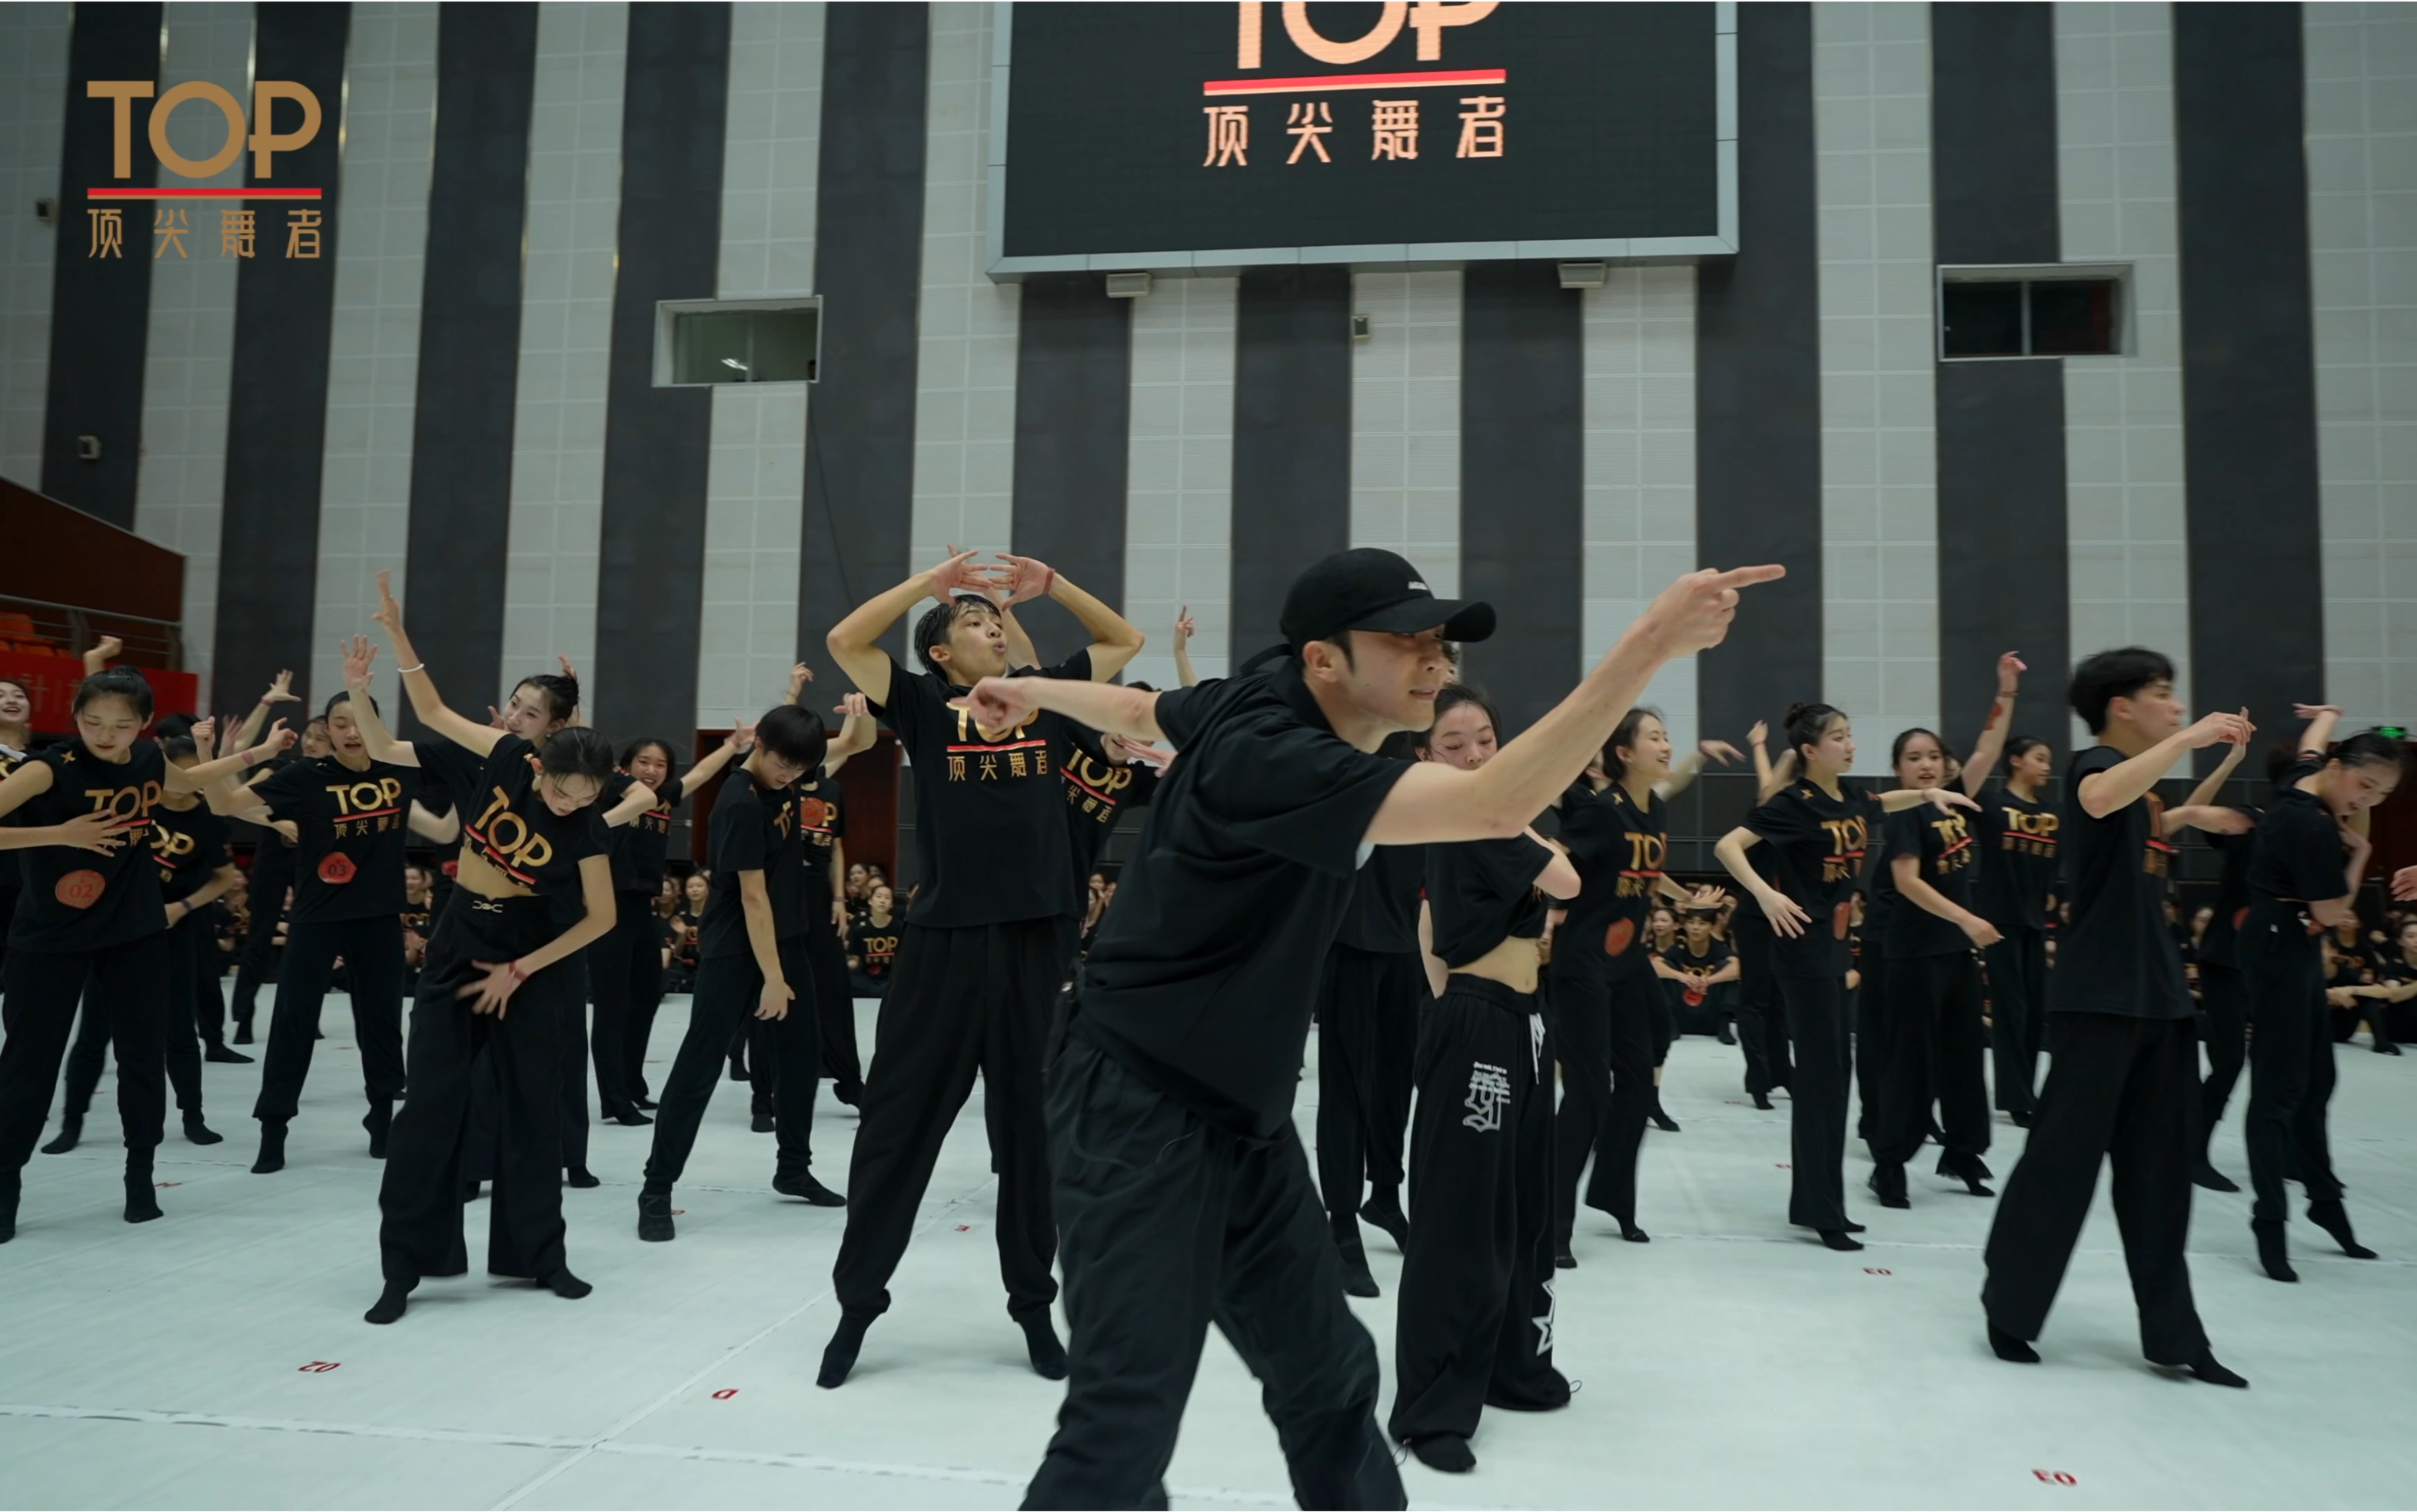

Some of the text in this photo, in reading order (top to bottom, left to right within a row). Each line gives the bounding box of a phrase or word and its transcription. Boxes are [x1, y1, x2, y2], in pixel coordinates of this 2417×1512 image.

[1204, 96, 1505, 168] 顶尖舞者
[946, 749, 1048, 782] 顶尖舞者
[85, 780, 162, 820] TOP
[325, 777, 402, 815] TOP
[1060, 775, 1113, 824] 尖舞者
[474, 785, 553, 869] TOP
[2000, 806, 2060, 837] TOP
[327, 863, 347, 876] 03
[69, 883, 94, 899] 02
[863, 935, 899, 953] TOP
[298, 1361, 341, 1374] 02
